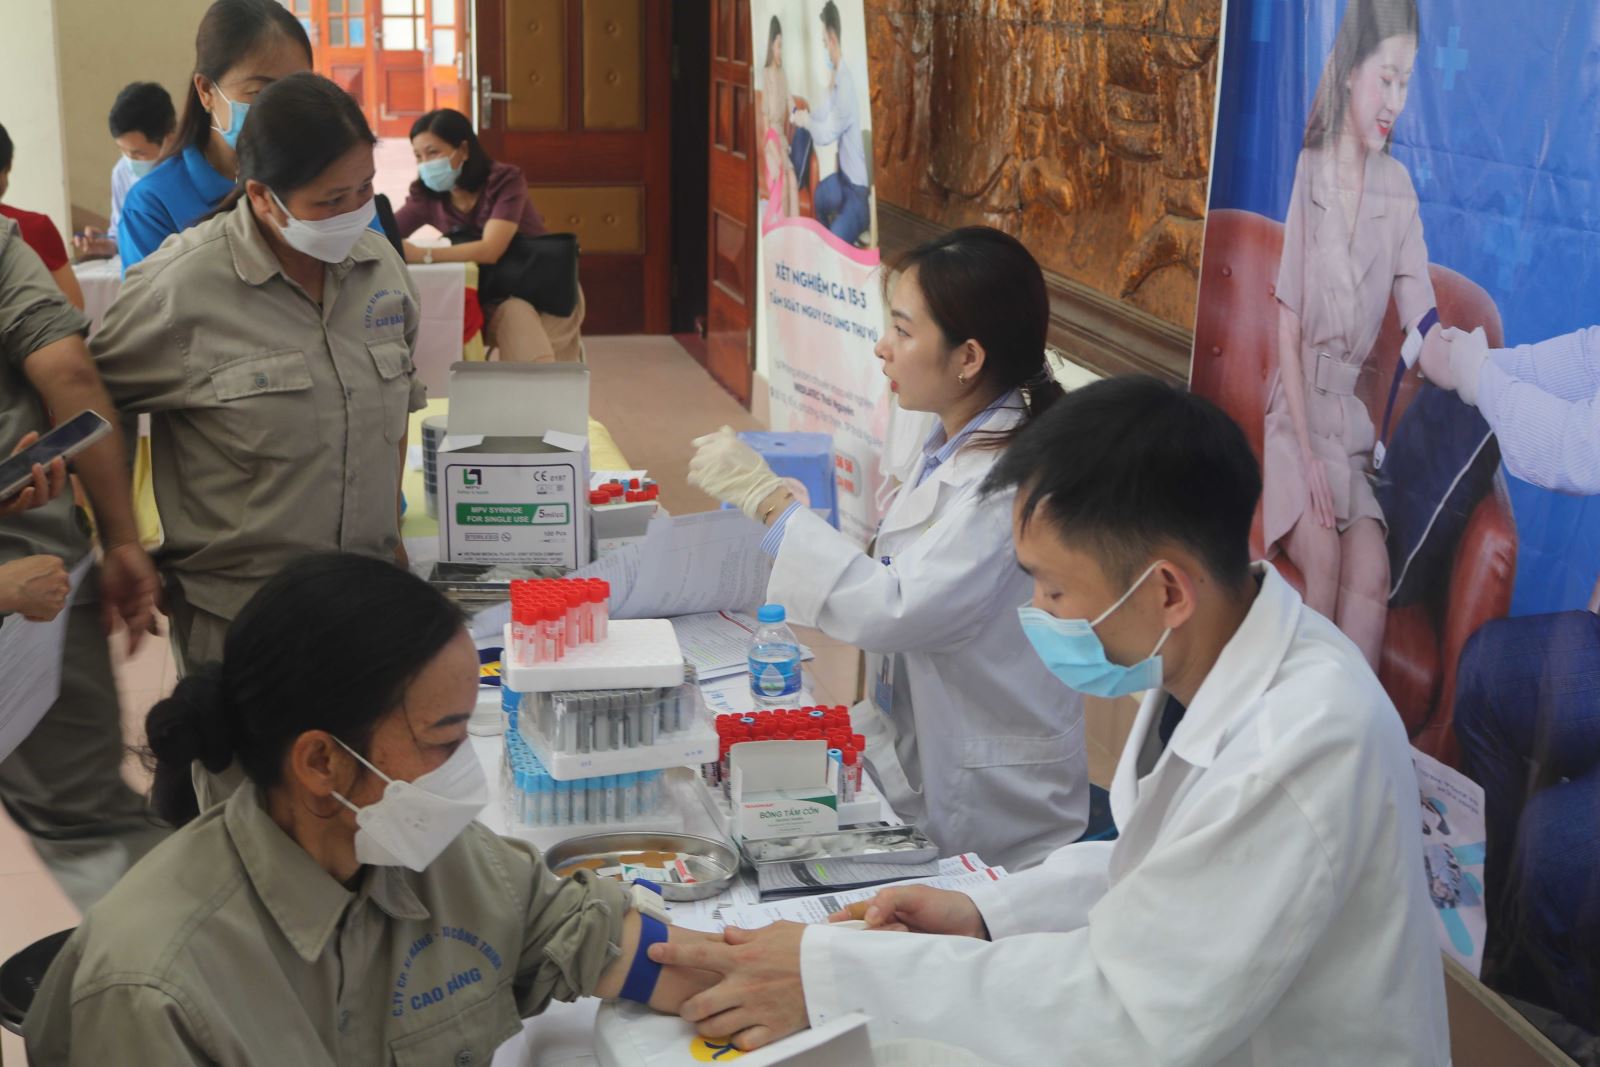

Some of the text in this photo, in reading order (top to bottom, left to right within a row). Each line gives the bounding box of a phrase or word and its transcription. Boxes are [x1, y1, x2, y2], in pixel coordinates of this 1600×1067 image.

[774, 260, 867, 309] XÉT NGHIỆM CA 15-3
[802, 304, 821, 321] NGUY
[376, 317, 388, 328] CAO
[760, 810, 782, 818] BÔNG
[410, 986, 444, 1010] CAO
